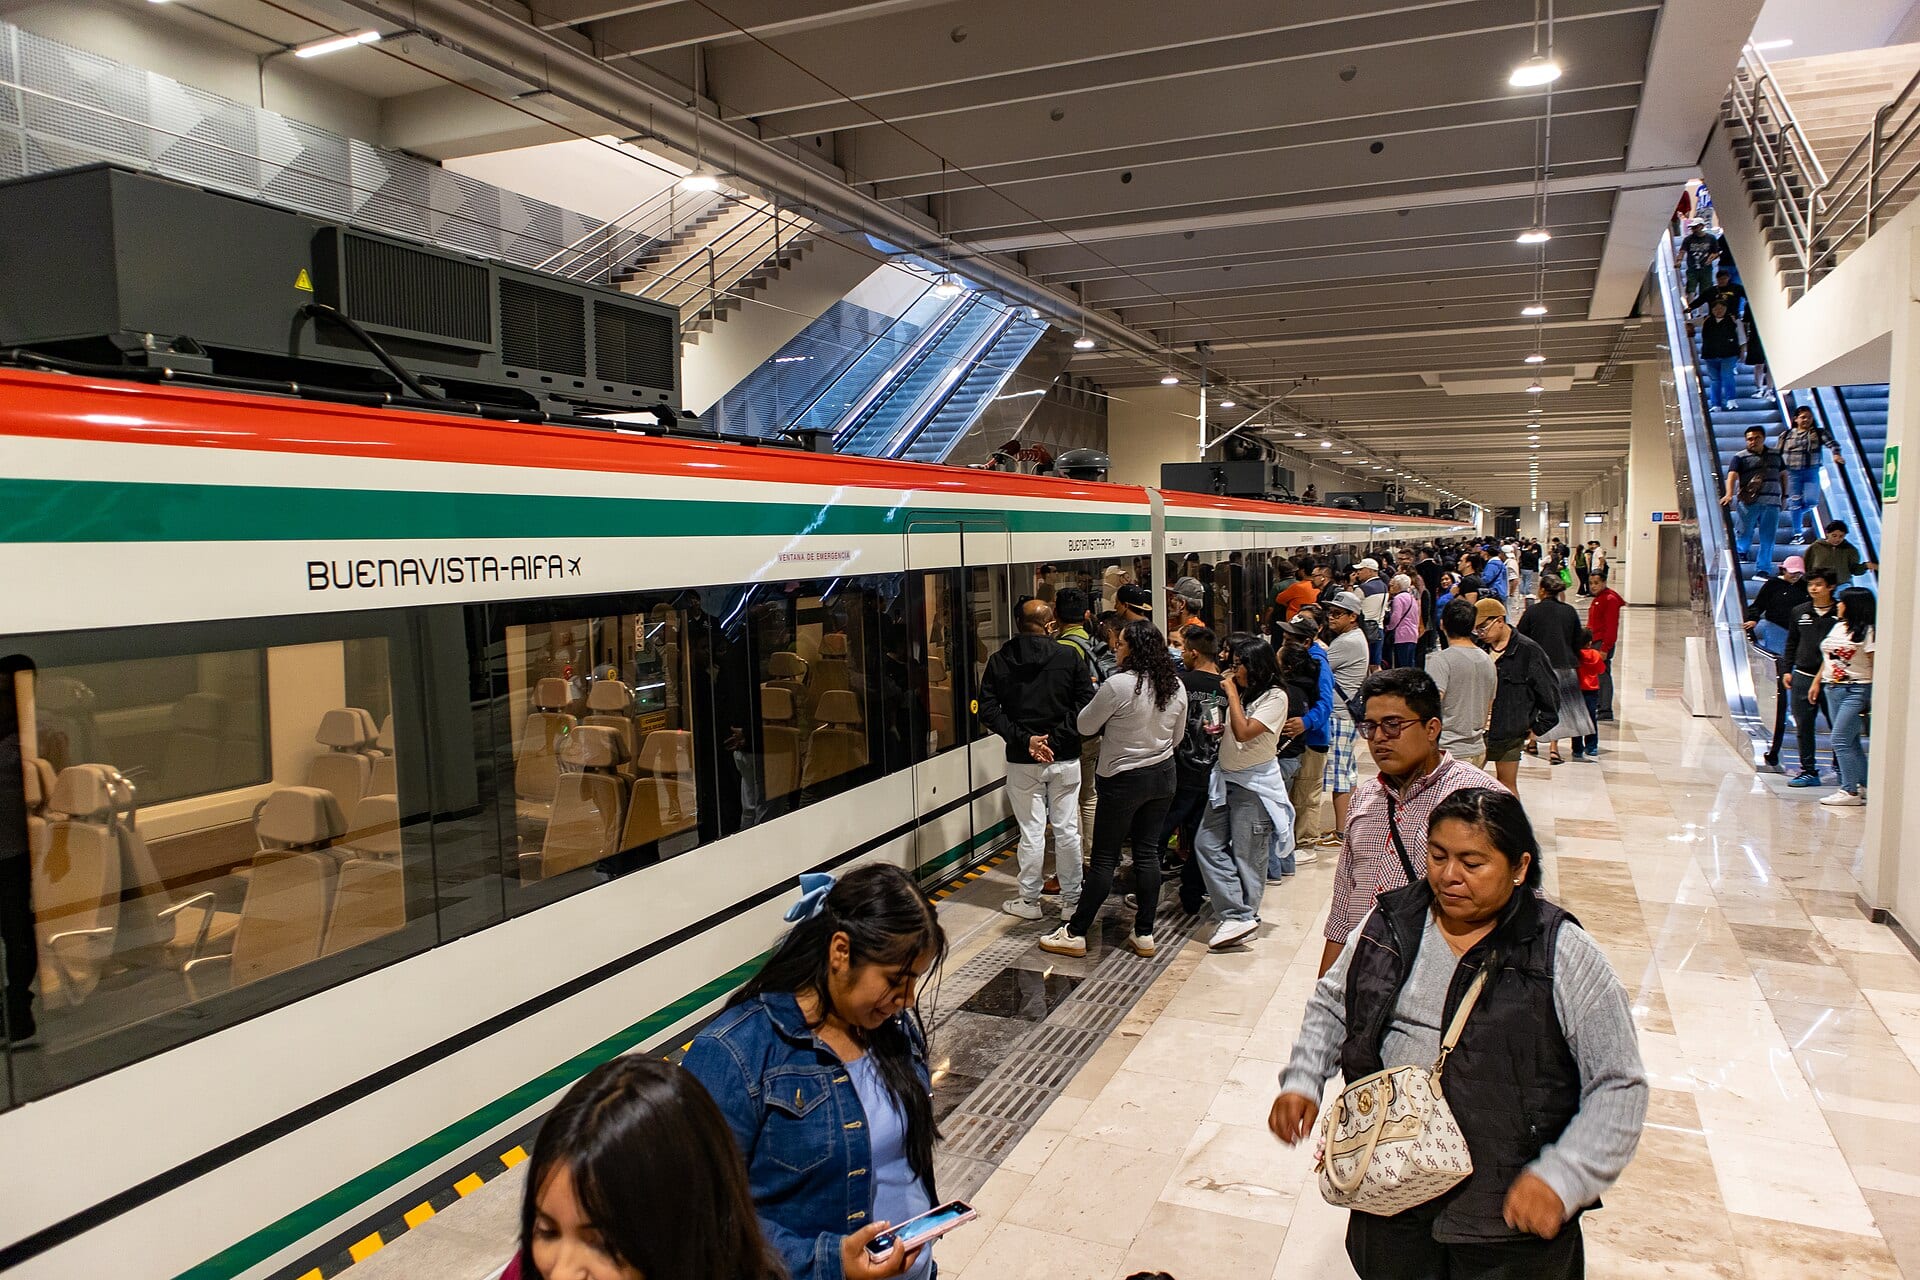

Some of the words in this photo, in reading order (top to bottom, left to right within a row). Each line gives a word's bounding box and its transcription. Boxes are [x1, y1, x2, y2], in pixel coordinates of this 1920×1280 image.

[779, 553, 804, 562] VENTANA
[807, 552, 814, 561] DE
[816, 551, 850, 560] EMERGENCIA
[306, 554, 564, 591] BUENAVISTA-AIFA
